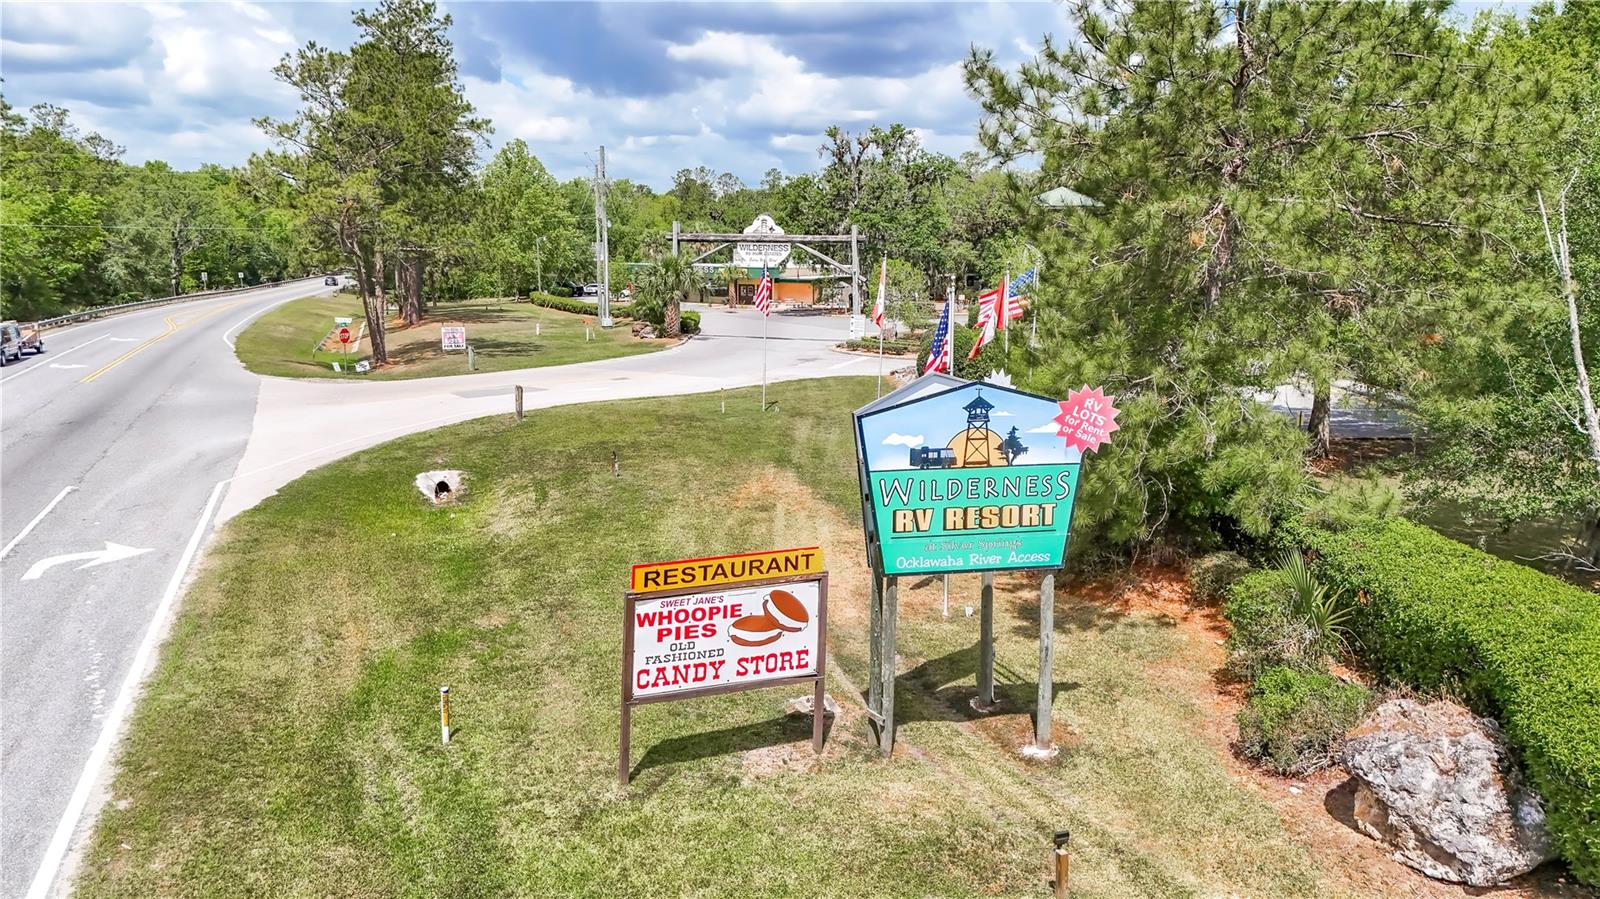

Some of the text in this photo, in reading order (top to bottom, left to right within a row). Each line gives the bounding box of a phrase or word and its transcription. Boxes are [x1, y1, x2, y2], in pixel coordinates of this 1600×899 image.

[739, 244, 789, 252] WILDERNESS
[1084, 397, 1103, 412] RV
[1064, 415, 1105, 436] for Rent
[1072, 406, 1106, 426] LOTS
[1062, 426, 1074, 434] or
[880, 471, 1070, 507] WILDERNESS
[893, 503, 1057, 533] RV RESORT
[896, 551, 1050, 569] Ocklawaha River Access
[643, 554, 815, 588] RESTAURANT
[660, 595, 724, 609] SWEET JANE'S
[636, 603, 742, 628] WHOOPIE
[657, 623, 717, 643] PIES
[645, 648, 725, 665] FASHIONED
[669, 641, 696, 652] OLD
[636, 649, 809, 690] CANDY STORE
